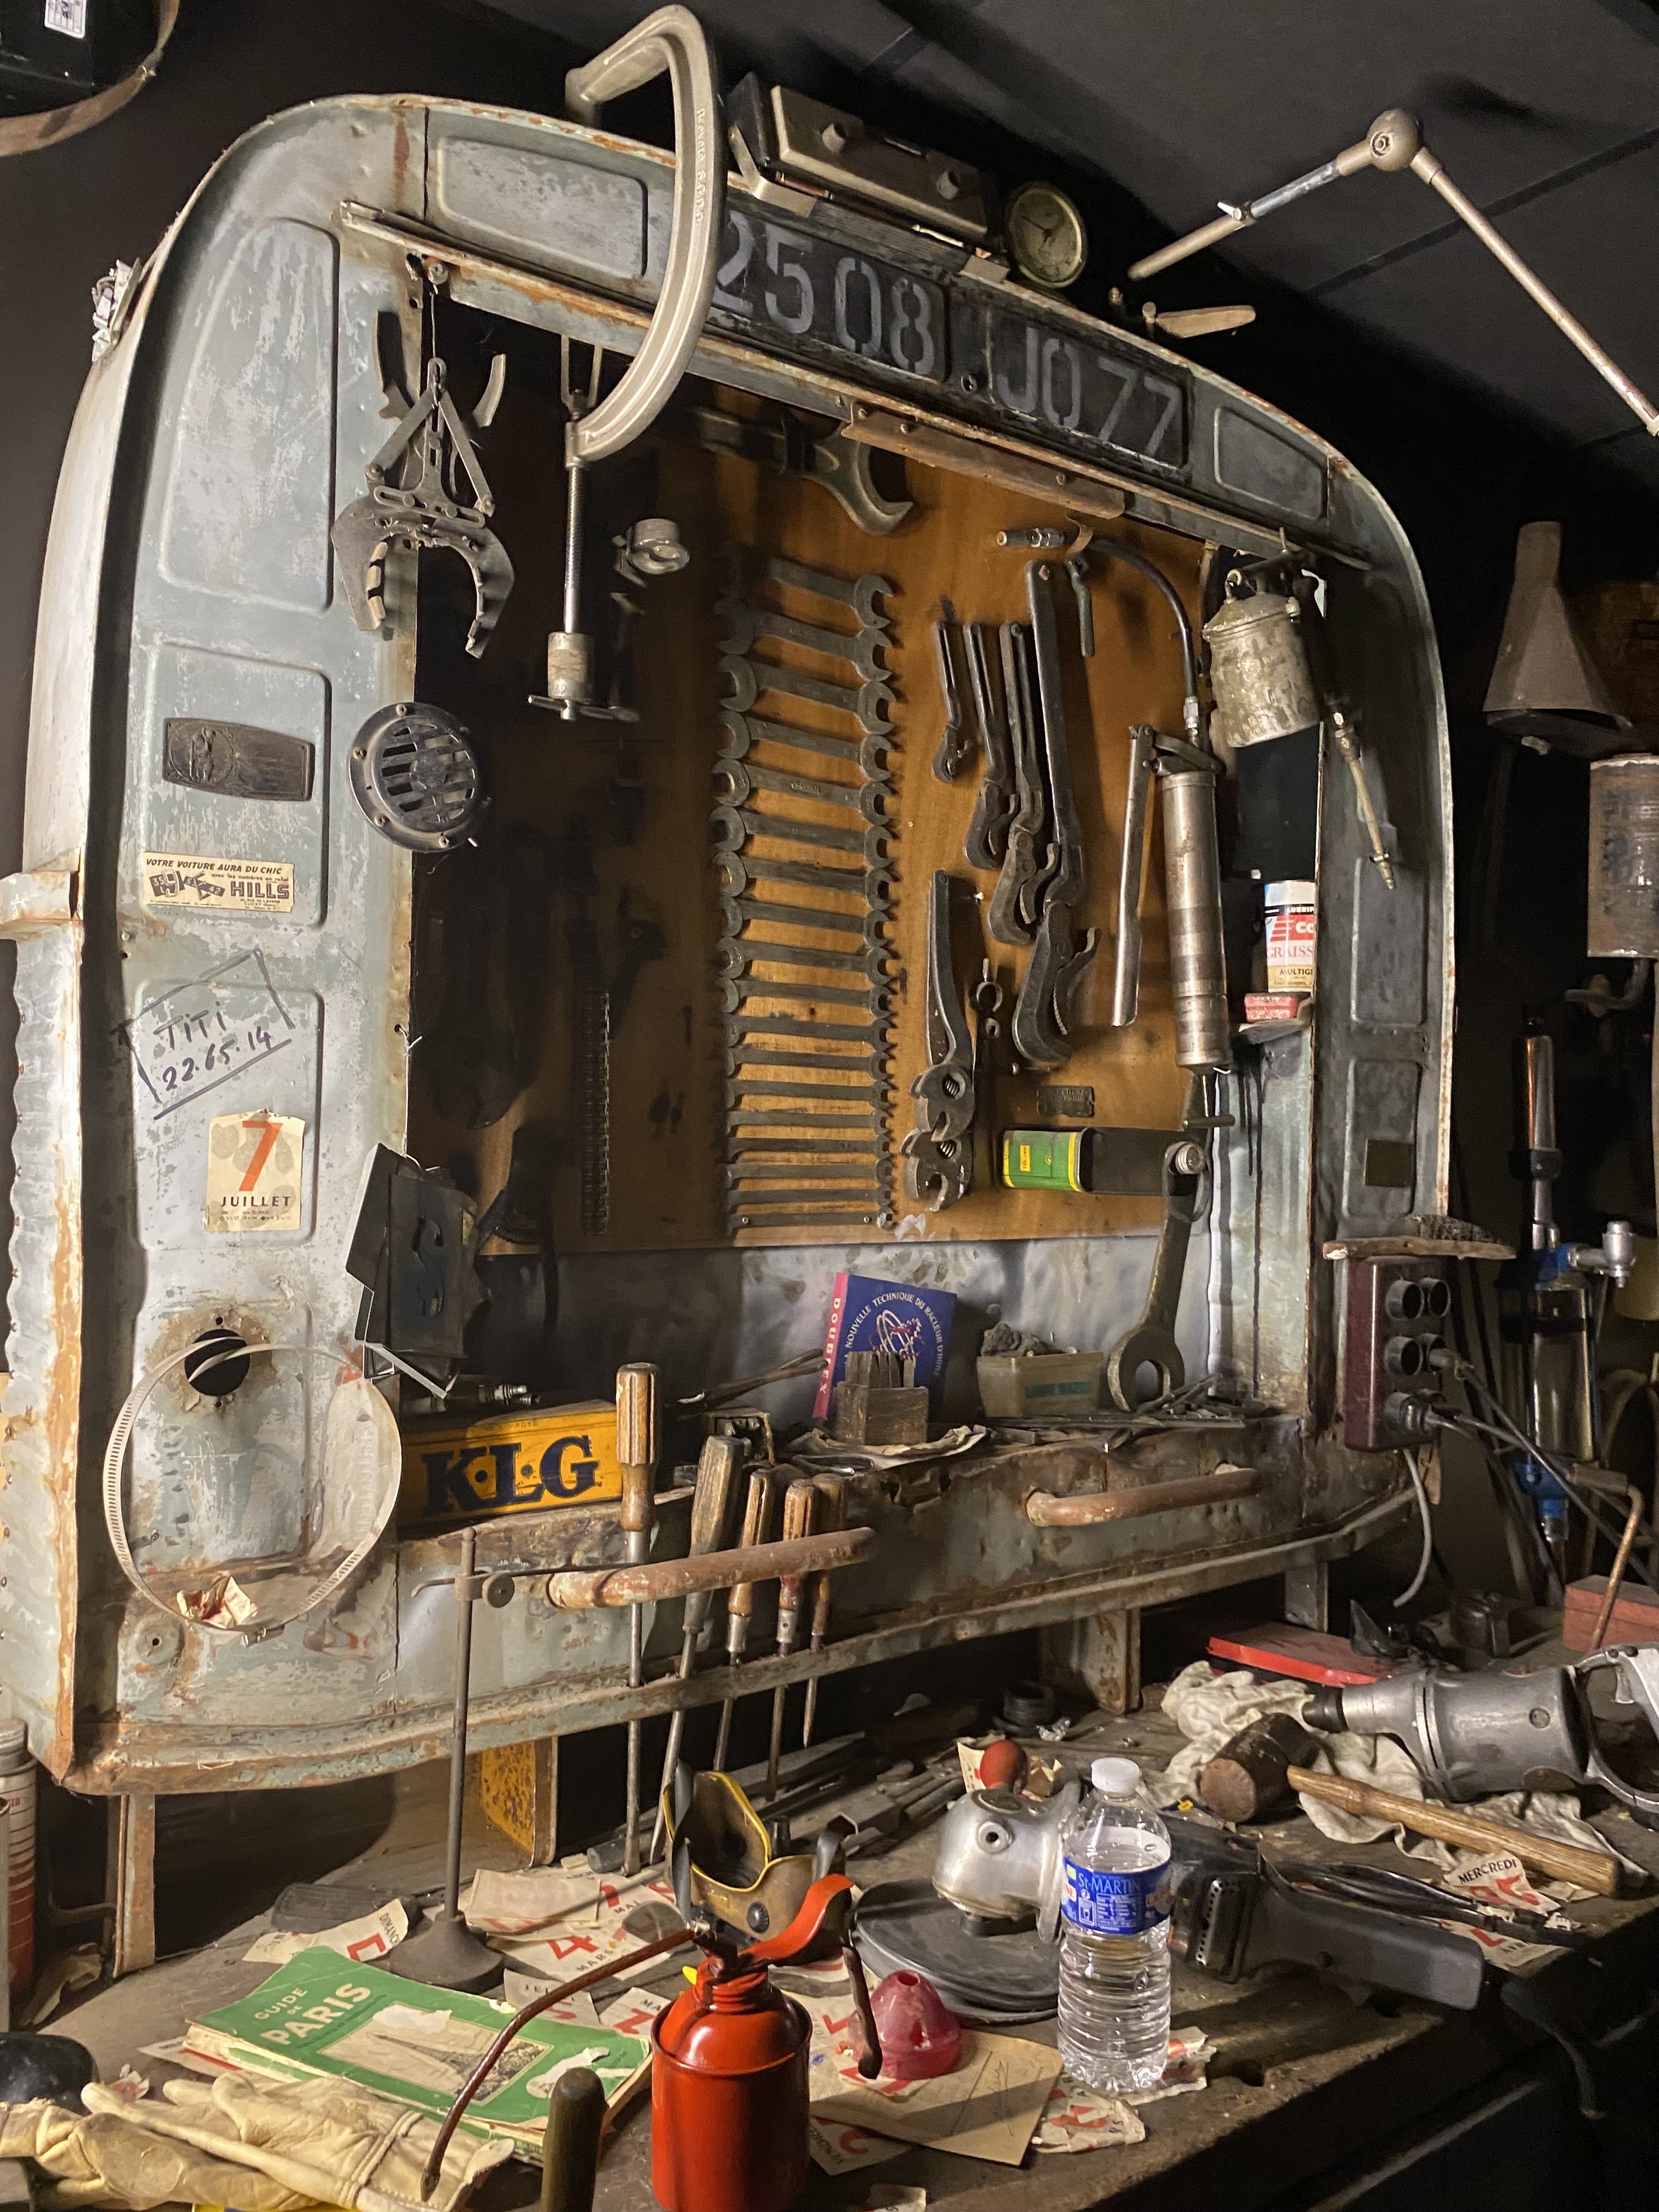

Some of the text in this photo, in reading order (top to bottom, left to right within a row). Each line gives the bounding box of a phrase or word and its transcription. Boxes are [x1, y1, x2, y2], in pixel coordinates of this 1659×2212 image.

[146, 858, 283, 875] VOTRE VOITURE AURA DU CHIC
[230, 881, 290, 899] HILLS
[239, 1120, 284, 1192] 7
[221, 1196, 291, 1207] JUILLET
[845, 1304, 872, 1348] NOUVELLE
[872, 1291, 915, 1308] TECHNIQUE
[915, 1297, 926, 1310] DU
[923, 1306, 943, 1345] RACLEUR
[1458, 1859, 1517, 1884] MERCREDI
[254, 1987, 309, 2020] GUIDE
[260, 1982, 371, 2046] PARIS
